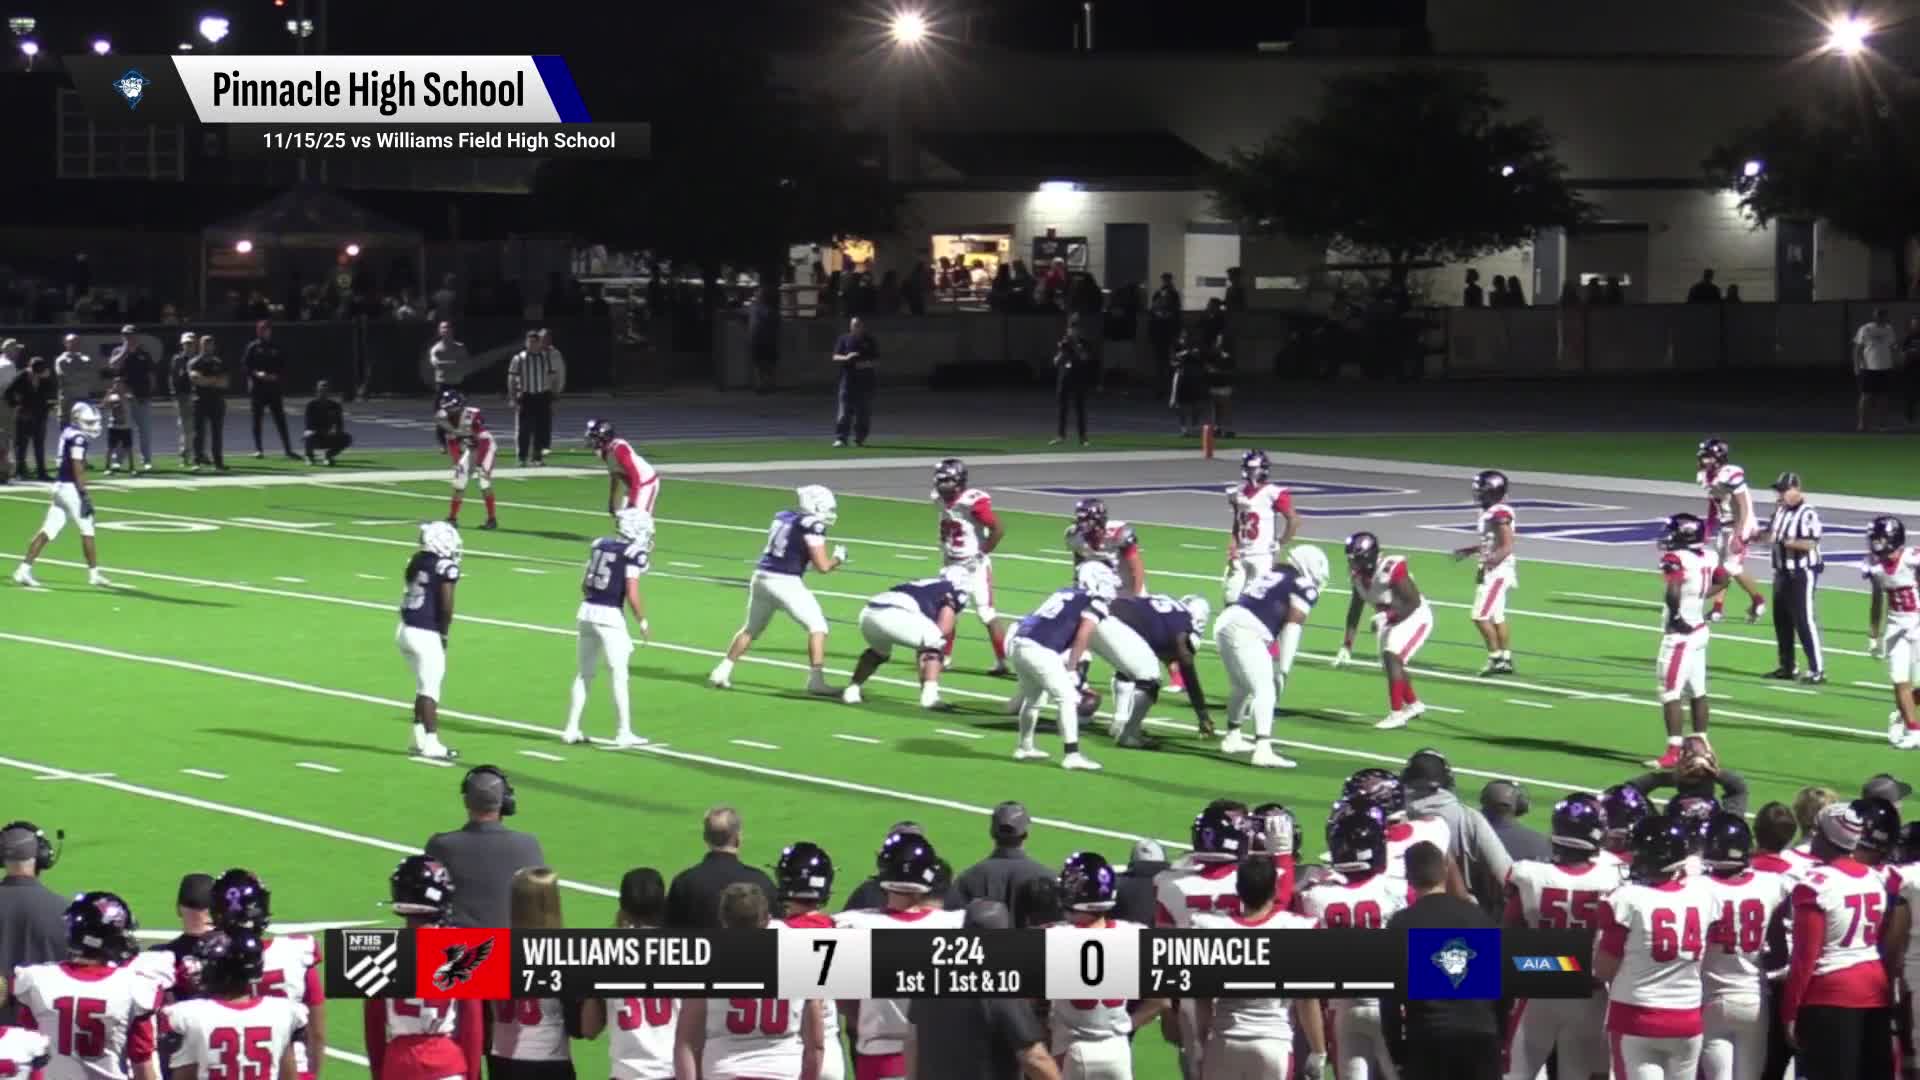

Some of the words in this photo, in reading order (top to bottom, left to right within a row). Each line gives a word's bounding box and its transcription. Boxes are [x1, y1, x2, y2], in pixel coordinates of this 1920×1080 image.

[1650, 907, 1702, 963] 64
[1706, 897, 1766, 956] 48
[1842, 892, 1884, 948] 75
[52, 997, 107, 1058] 15
[208, 1026, 272, 1080] 35
